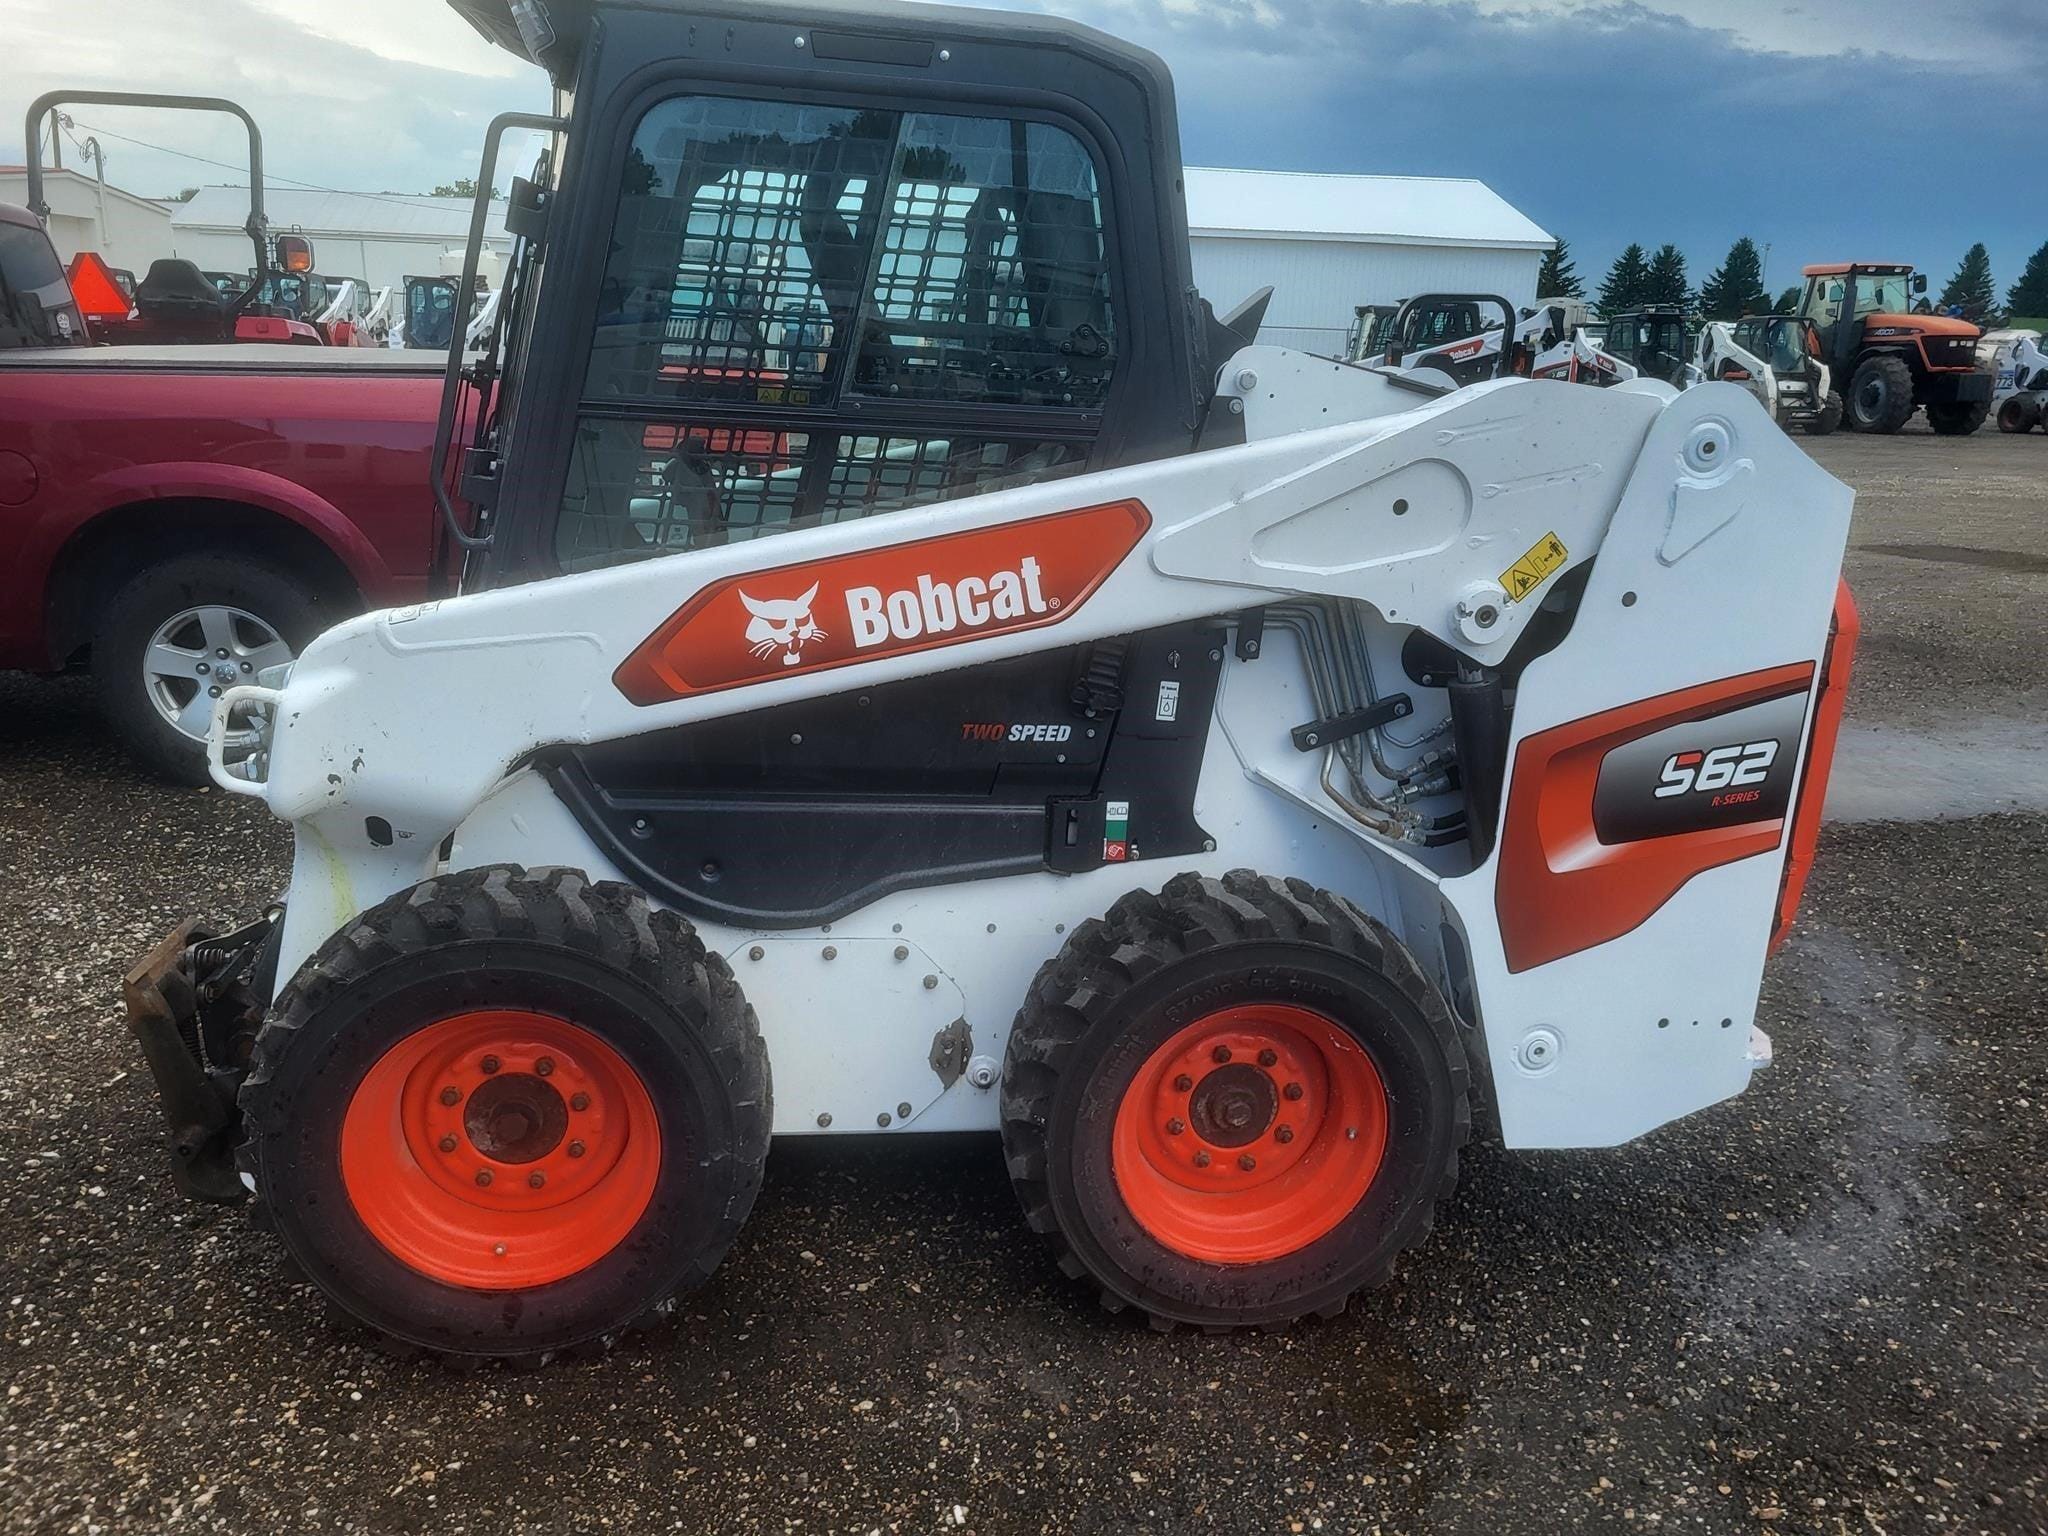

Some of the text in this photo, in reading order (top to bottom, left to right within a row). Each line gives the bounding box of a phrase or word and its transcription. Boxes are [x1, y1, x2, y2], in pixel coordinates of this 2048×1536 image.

[1874, 328, 1895, 336] AGCO
[845, 556, 1047, 648] Bobcat
[962, 723, 1071, 742] TWO SPEED
[1653, 739, 1780, 798] S62
[1711, 790, 1760, 807] R-SERIES
